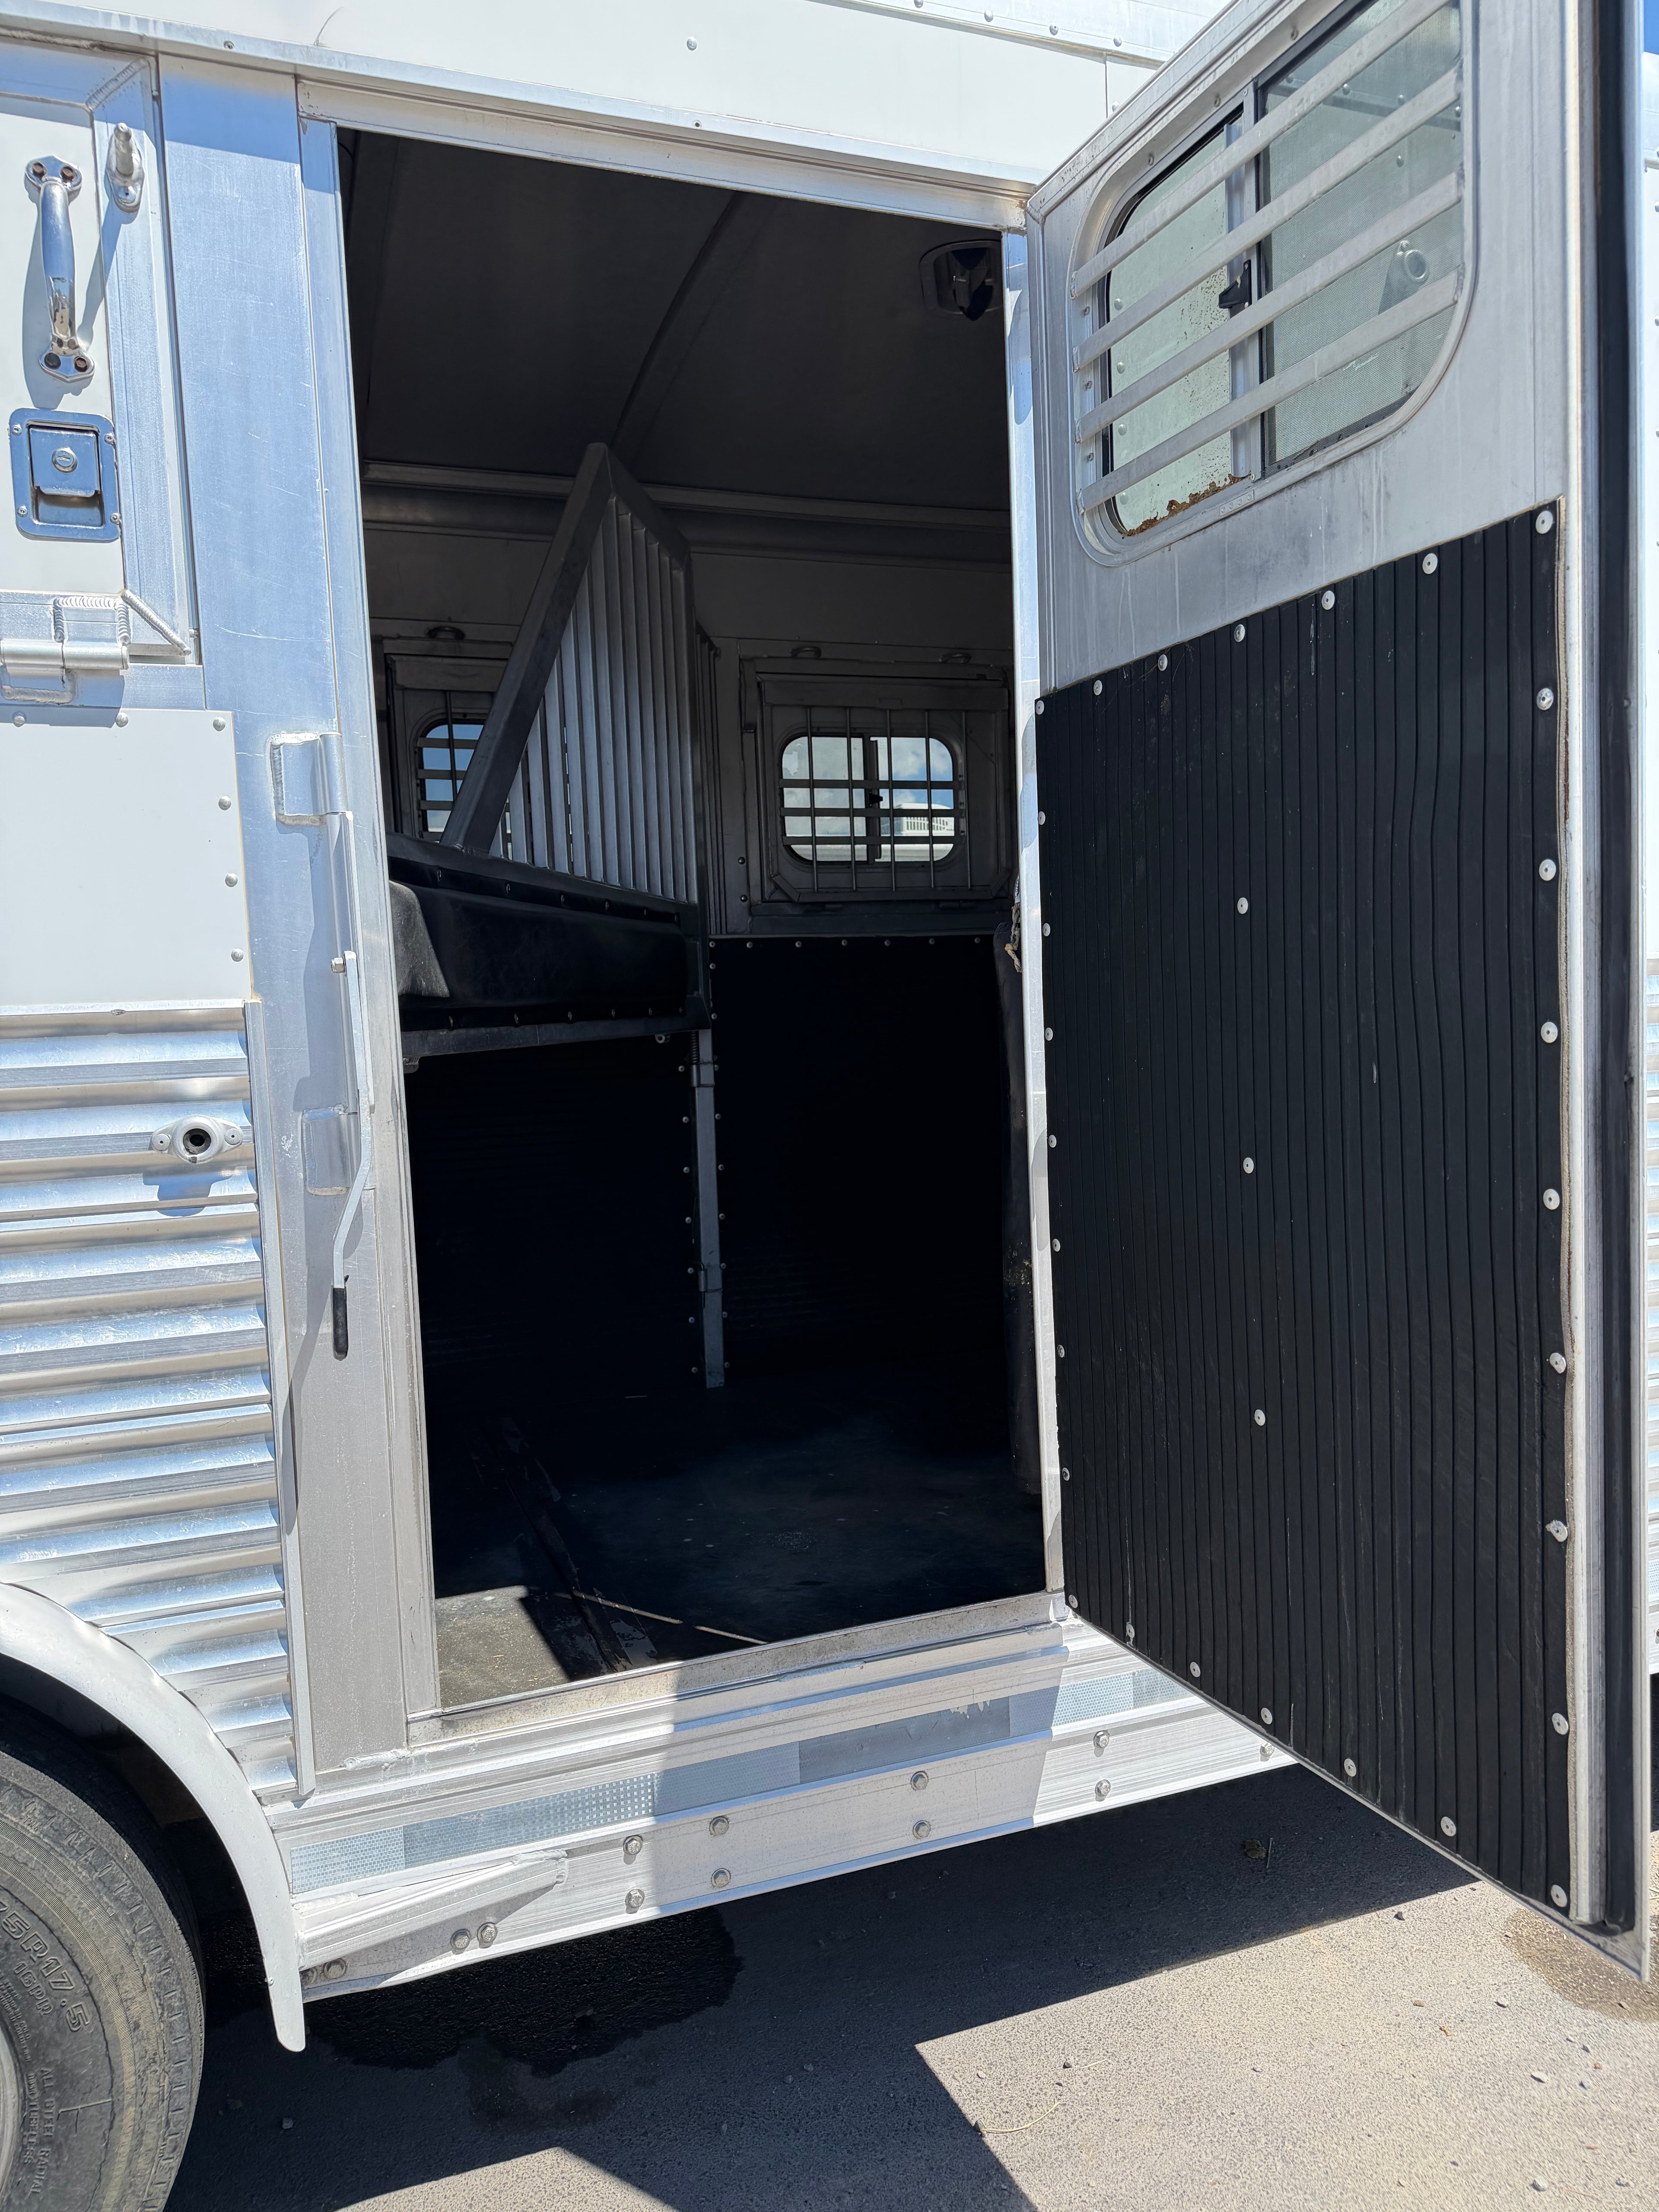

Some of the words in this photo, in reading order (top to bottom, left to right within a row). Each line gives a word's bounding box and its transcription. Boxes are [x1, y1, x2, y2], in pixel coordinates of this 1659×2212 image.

[13, 1961, 53, 2016] 16PR
[41, 2068, 55, 2092] ALL
[24, 2099, 40, 2165] TUBELESS
[43, 2098, 55, 2137] STEEL
[32, 2148, 51, 2193] RADIAL
